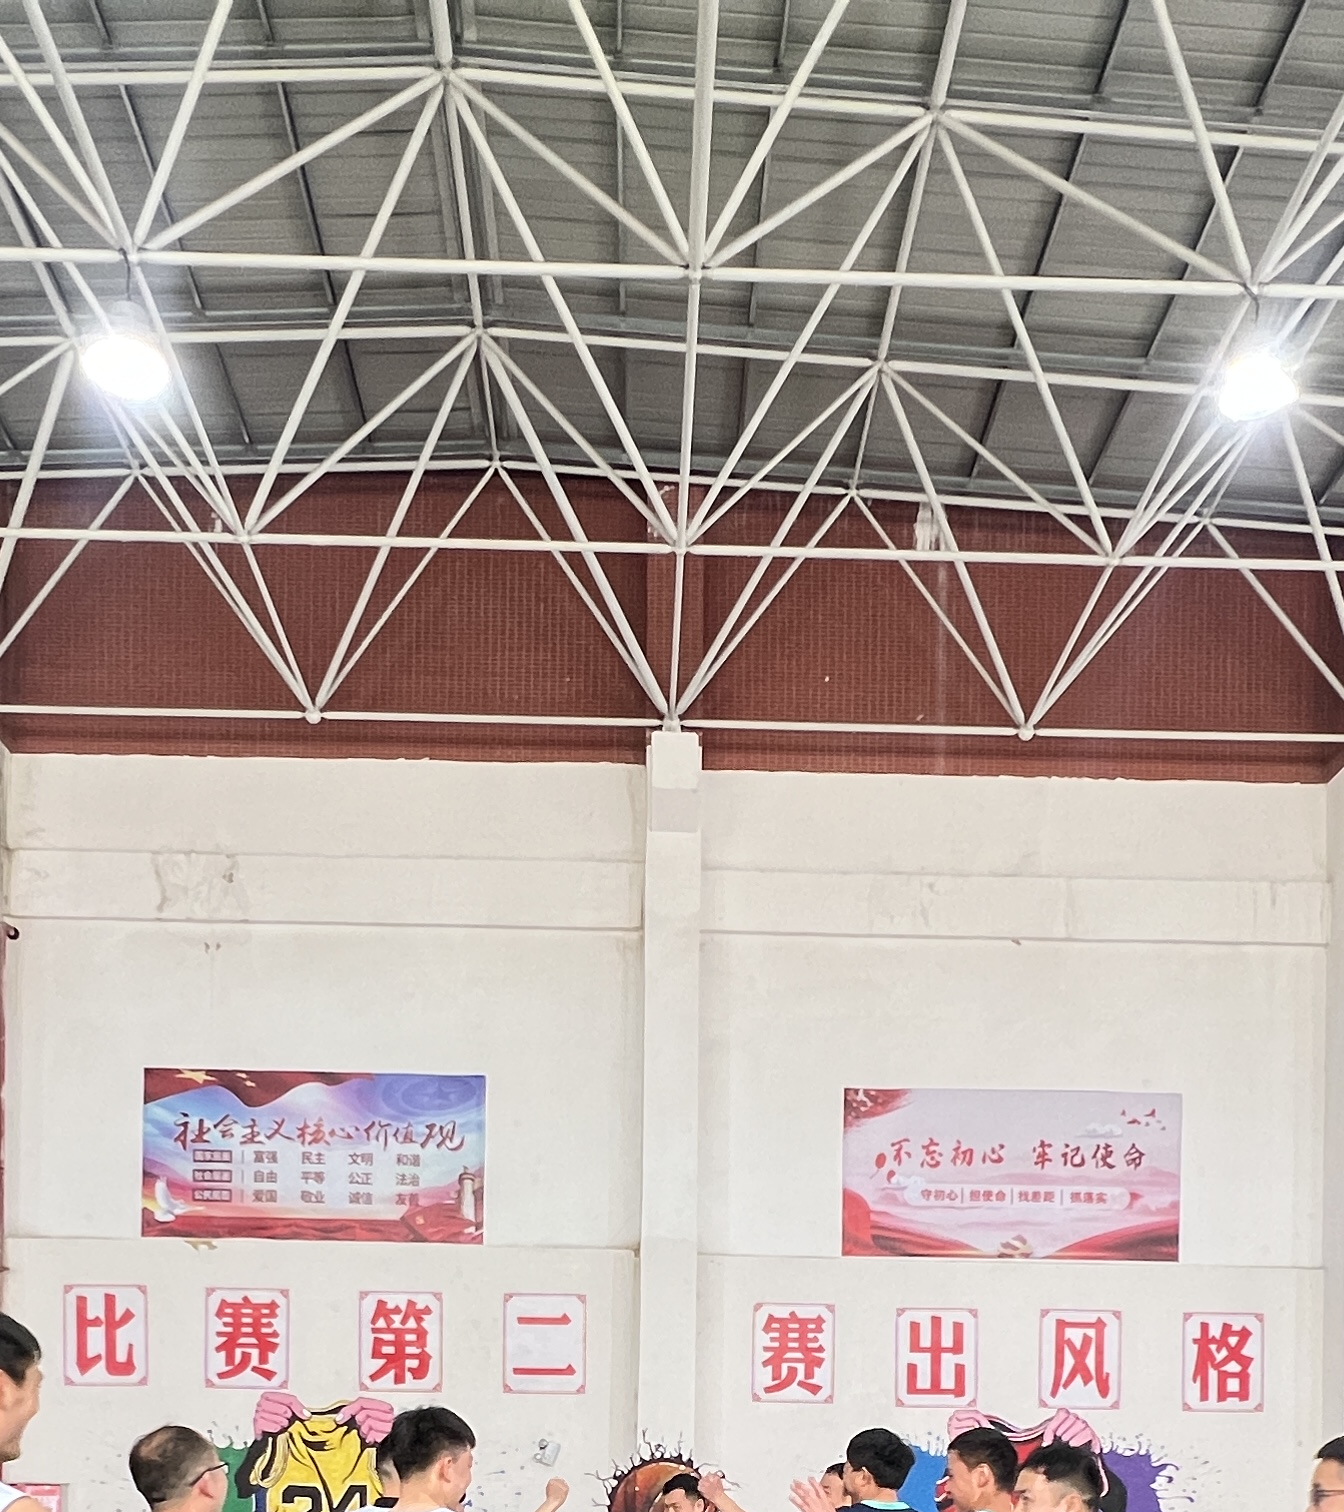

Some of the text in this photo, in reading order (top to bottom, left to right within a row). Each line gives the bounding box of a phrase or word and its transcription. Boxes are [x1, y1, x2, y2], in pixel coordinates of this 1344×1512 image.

[173, 1111, 466, 1152] 社会主义核心价值观
[253, 1150, 421, 1167] 富强 民主 文明 和谐
[890, 1137, 1147, 1171] 不忘初心 牢记使命
[253, 1169, 278, 1183] 自由
[348, 1172, 373, 1186] 公正
[395, 1172, 420, 1187] 法治
[920, 1188, 959, 1202] 守初心
[75, 1293, 577, 1386] 比赛第二
[761, 1310, 1255, 1404] 赛出风格
